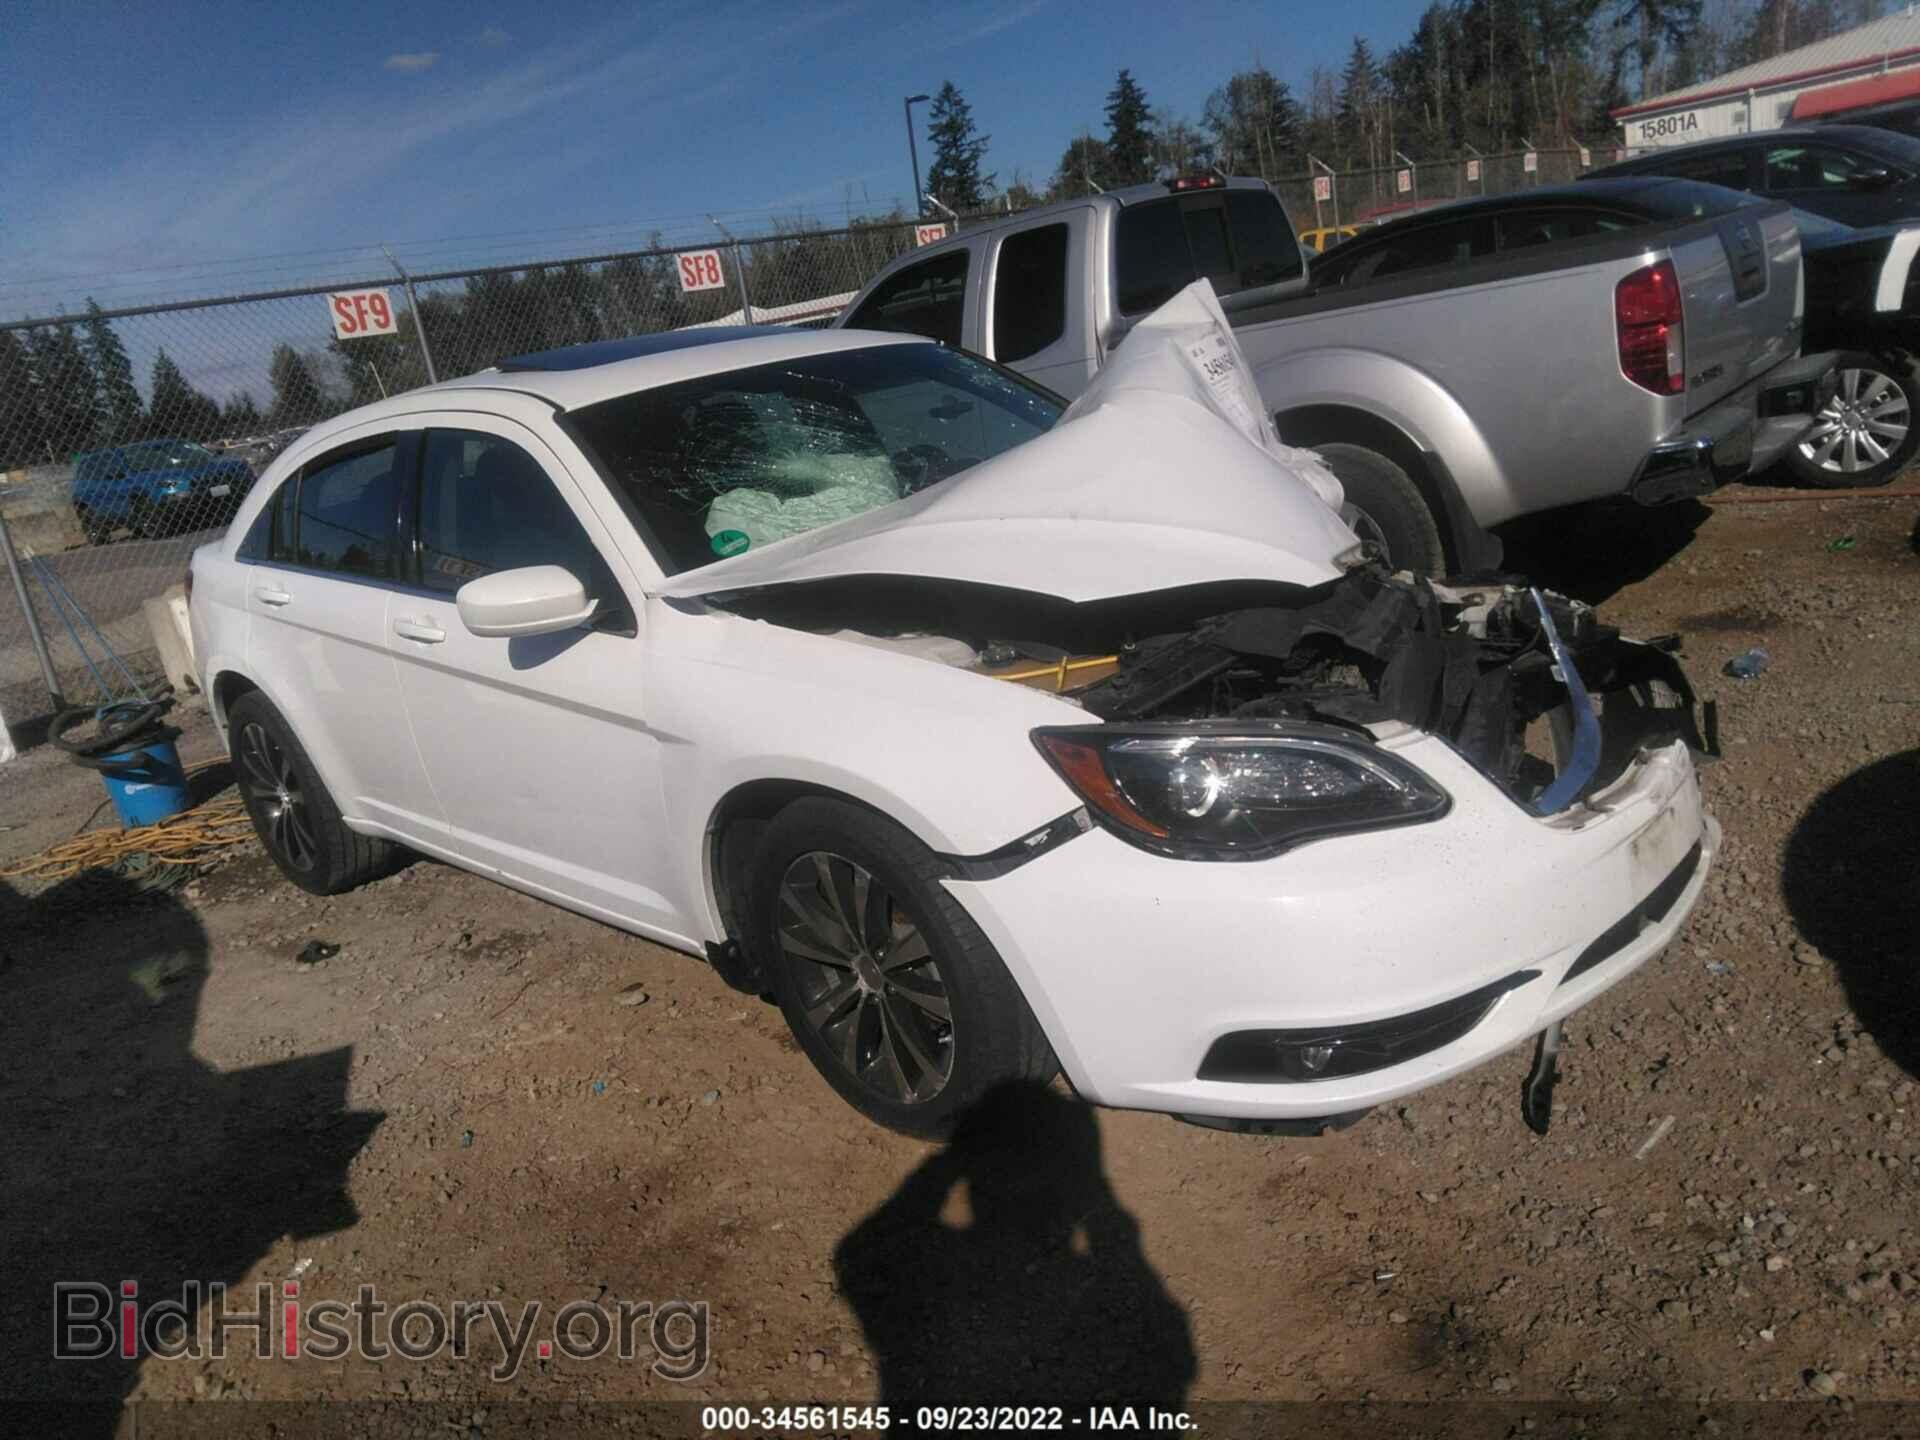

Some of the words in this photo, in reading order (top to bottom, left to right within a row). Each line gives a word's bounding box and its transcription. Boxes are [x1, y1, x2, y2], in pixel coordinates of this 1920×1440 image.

[1638, 112, 1698, 138] 15801A
[683, 254, 722, 288] SF8
[334, 294, 391, 334] SF9
